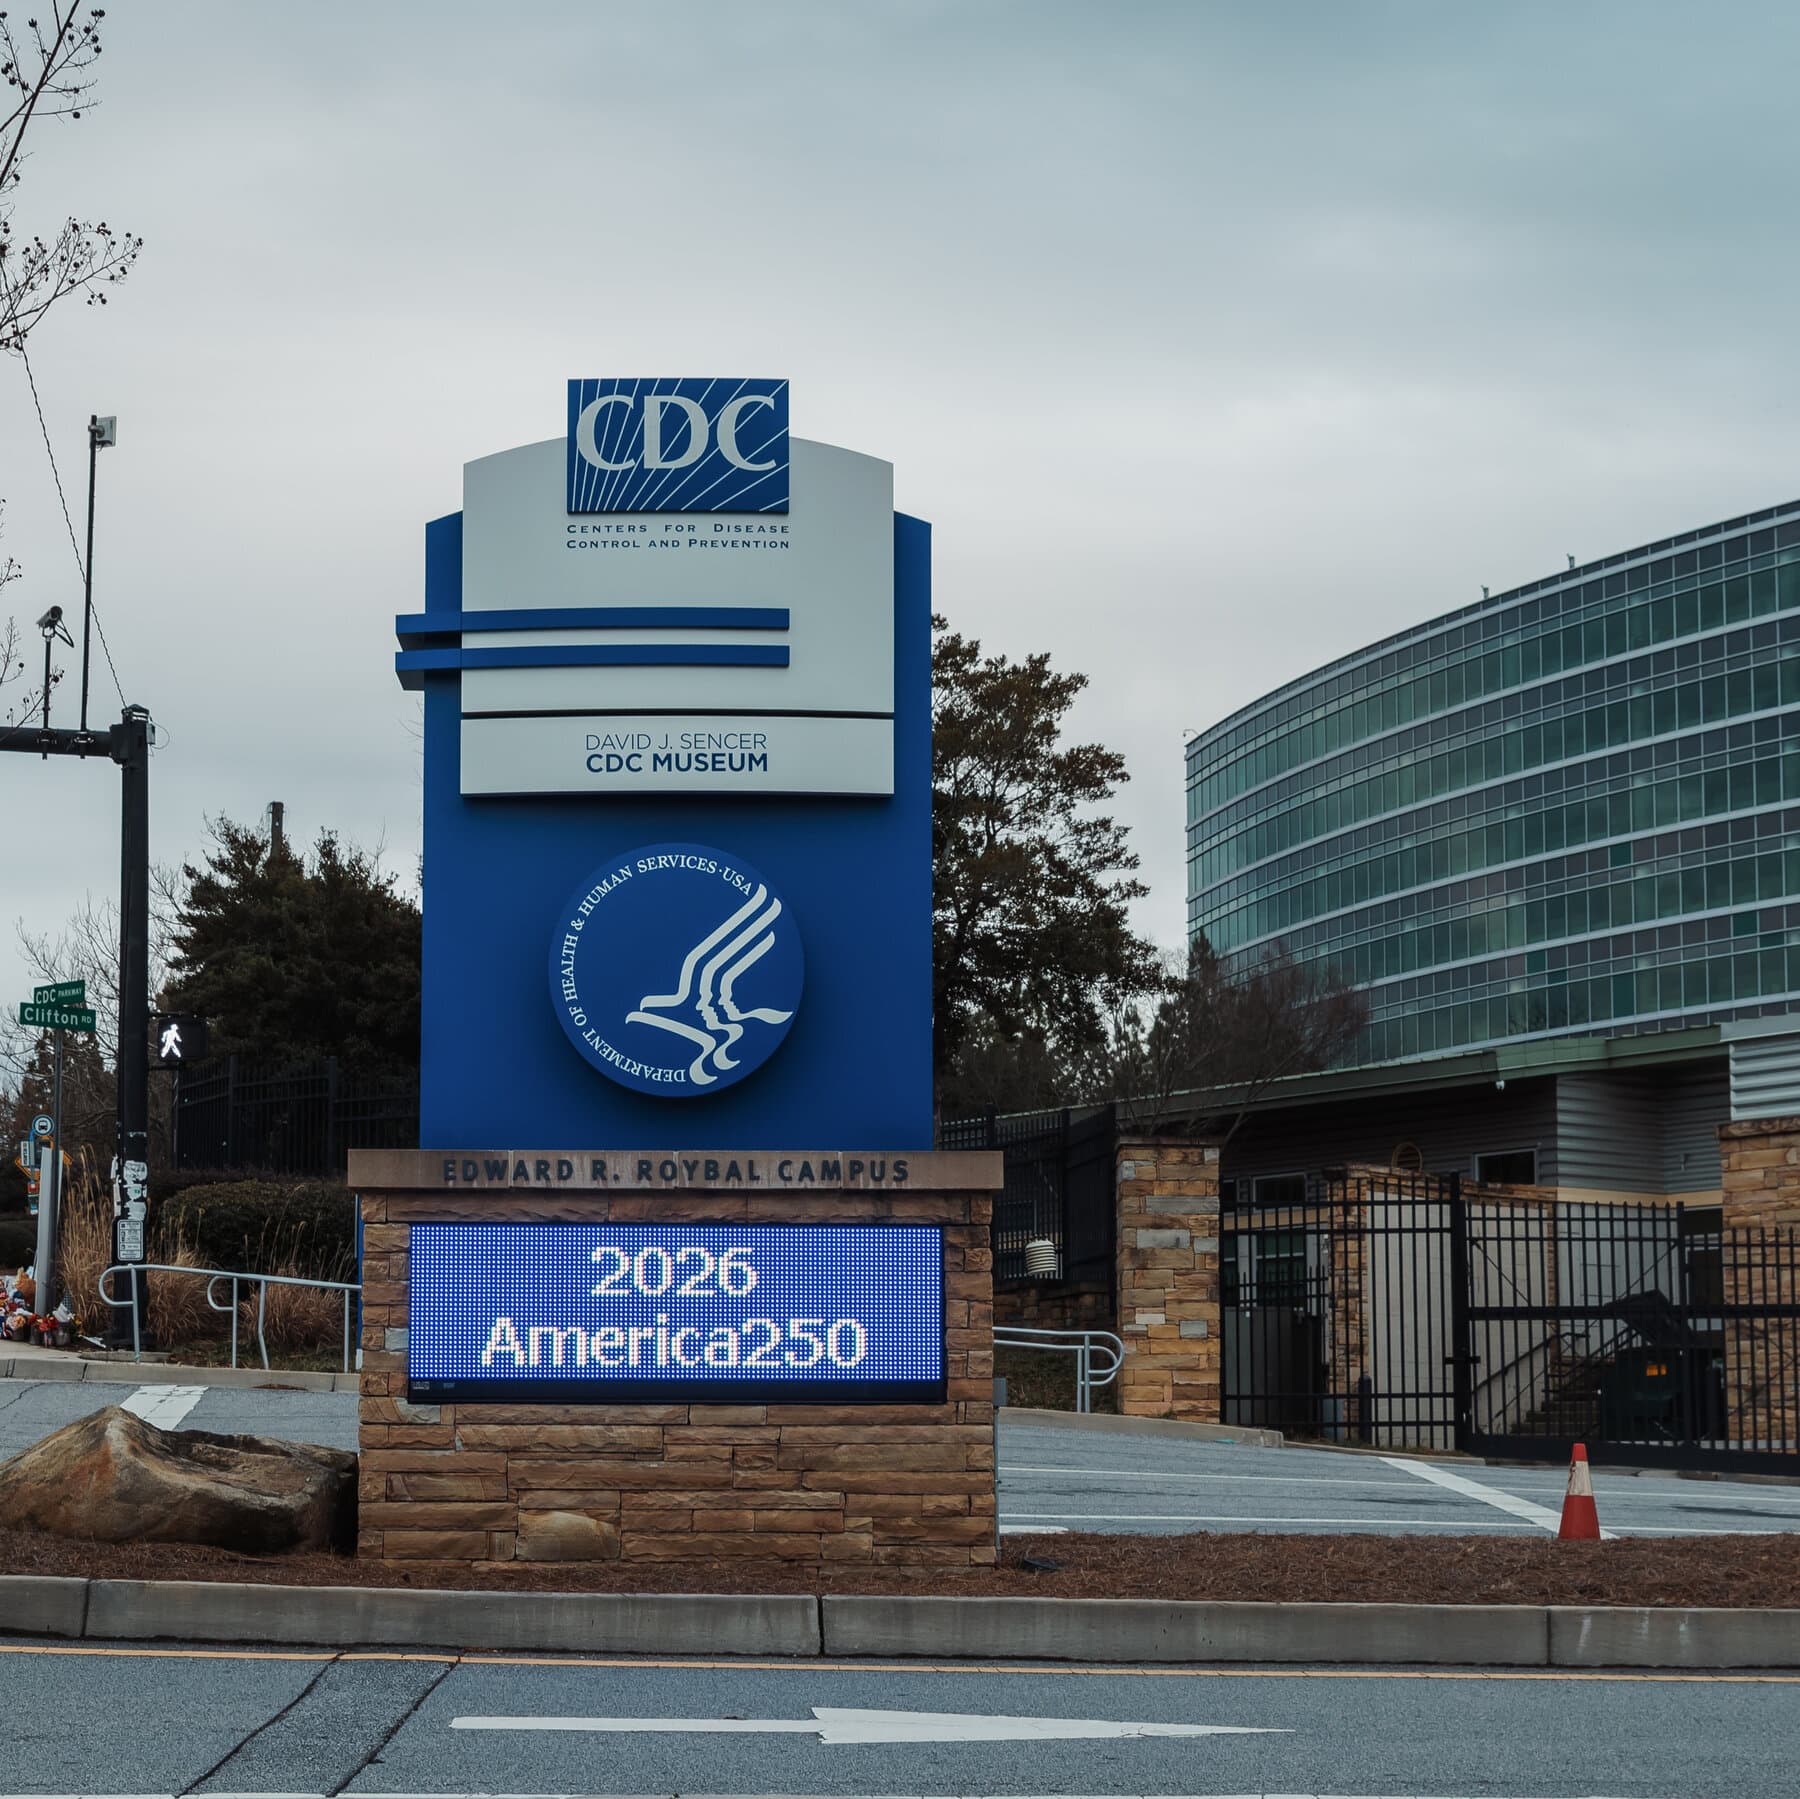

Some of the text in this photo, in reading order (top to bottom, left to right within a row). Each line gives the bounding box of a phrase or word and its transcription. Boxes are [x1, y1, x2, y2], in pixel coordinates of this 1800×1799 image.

[576, 394, 777, 471] CDC
[567, 523, 790, 534] CENTERS FOR DISEASE
[566, 538, 790, 549] CONTROL AND PREVENTION
[585, 733, 767, 751] DAVID J. SENCER
[586, 752, 768, 773] CDC MUSEUM
[578, 865, 634, 917] HUMAN
[570, 917, 585, 932] &
[560, 933, 579, 1002] HEALTH
[35, 987, 82, 1005] CDC PARKWAY
[24, 1007, 92, 1026] Clifton RD
[568, 1005, 588, 1027] OF
[582, 1028, 686, 1083] DEPARTMENT
[443, 1159, 910, 1182] EDWARD R. ROYBAL CAMPUS
[590, 1245, 759, 1298] 2026
[480, 1313, 869, 1370] America250
